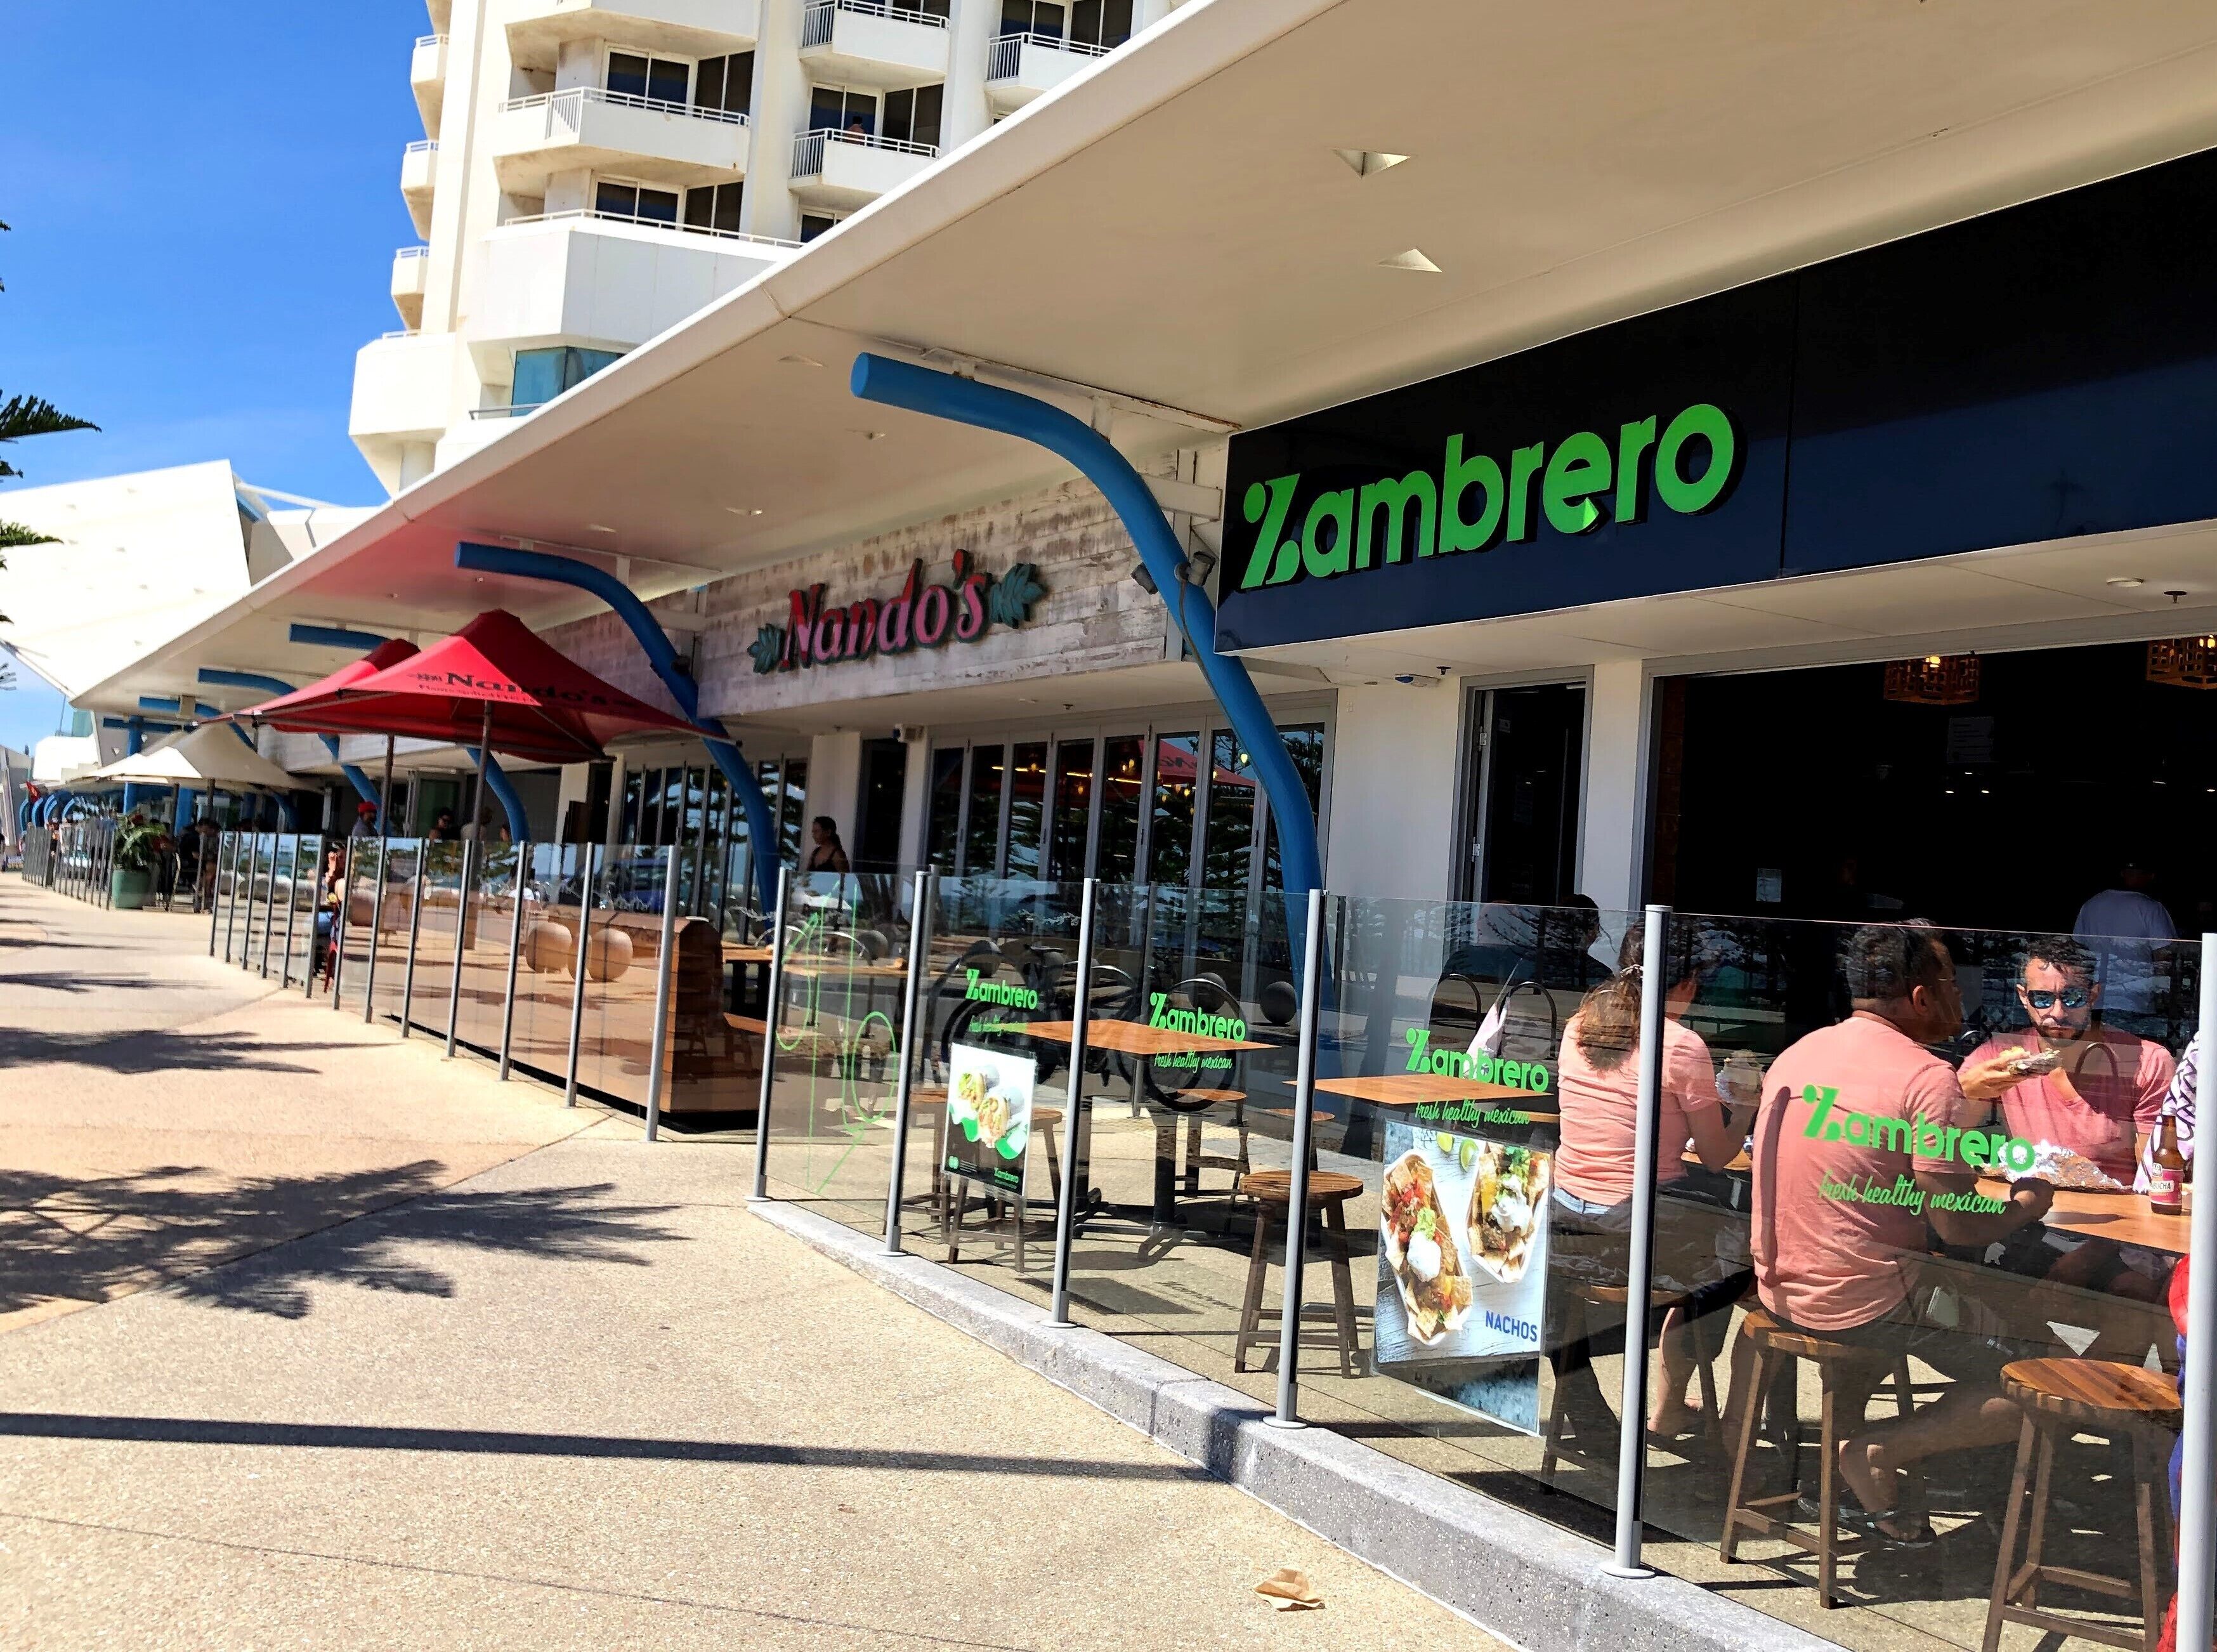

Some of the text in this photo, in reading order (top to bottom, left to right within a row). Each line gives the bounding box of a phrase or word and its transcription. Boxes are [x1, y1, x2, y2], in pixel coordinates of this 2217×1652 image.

[1240, 403, 1735, 589] Zambrero
[778, 549, 991, 669] Nando's
[965, 968, 1038, 1010] Zambrero
[1149, 992, 1245, 1042] Zambrero
[1406, 1028, 1549, 1093] Zambrero
[1415, 1096, 1531, 1129] fresh healthy mexican
[1802, 1084, 2036, 1173] Zambrero
[1818, 1170, 2006, 1216] fresh healthy mexican
[1485, 1310, 1538, 1342] NACHOS
